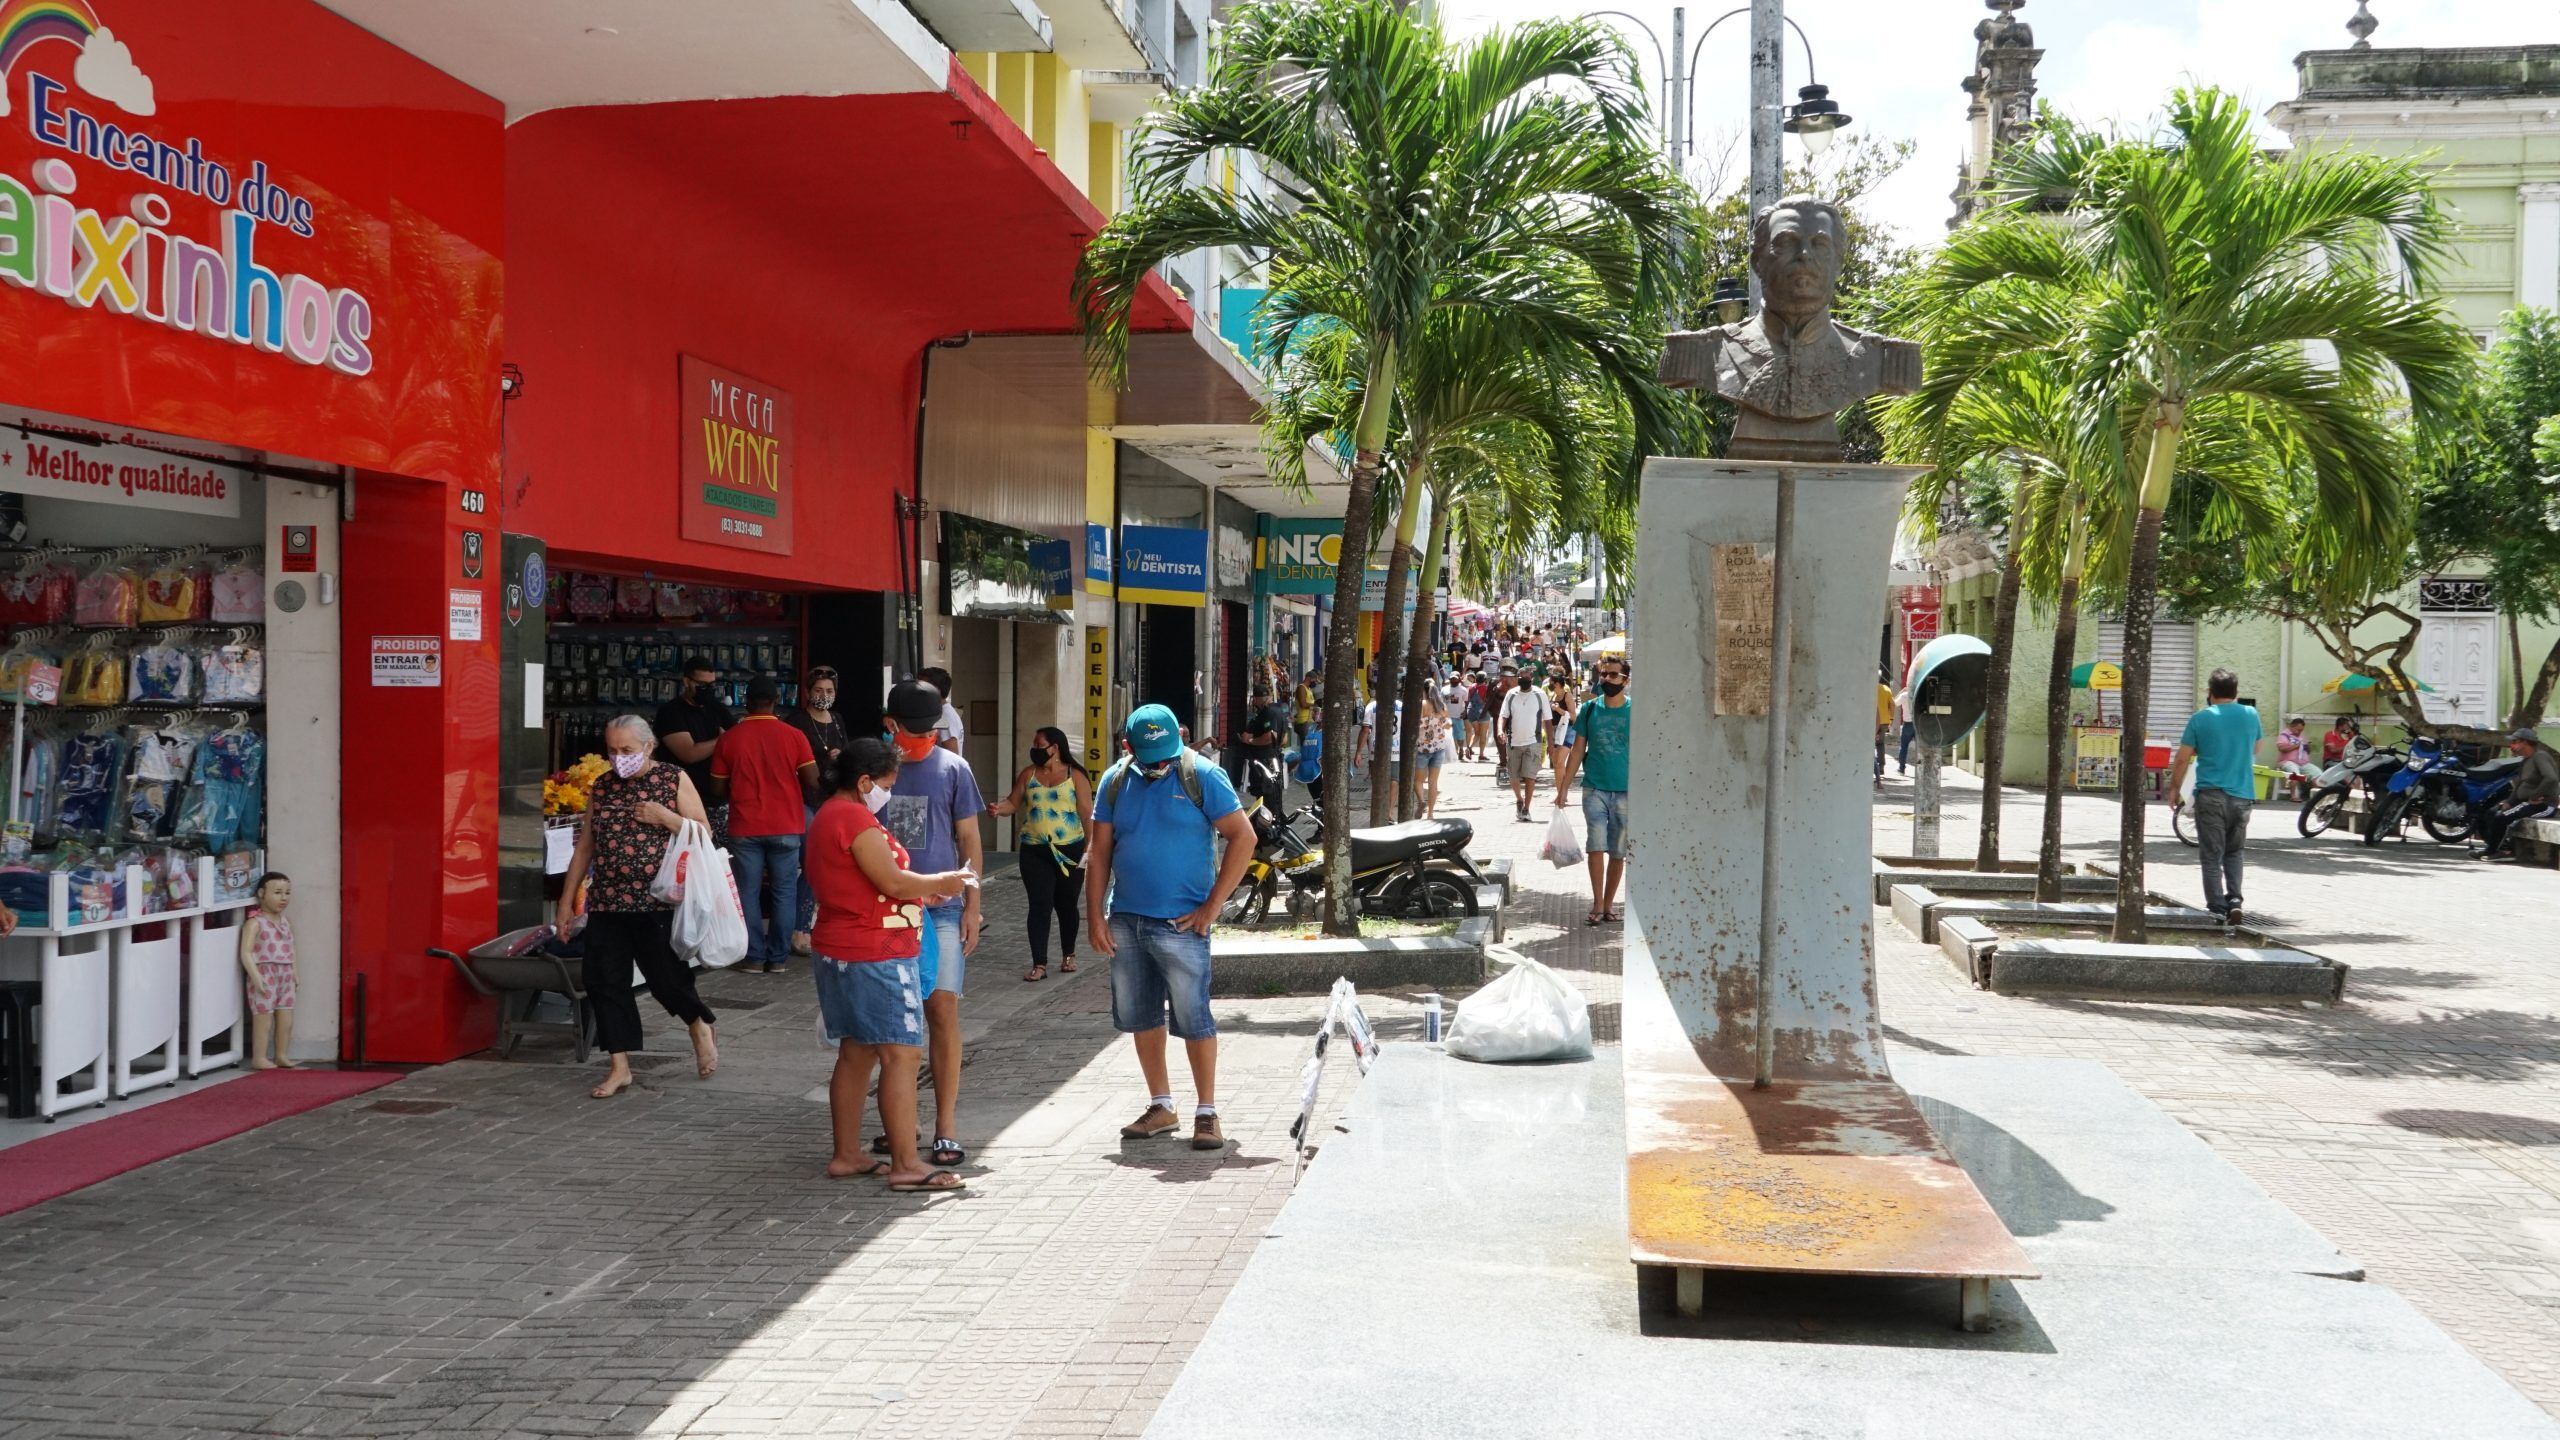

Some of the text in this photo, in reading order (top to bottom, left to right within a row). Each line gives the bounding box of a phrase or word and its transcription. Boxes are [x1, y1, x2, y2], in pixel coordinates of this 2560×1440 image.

[28, 73, 314, 237] Encanto dos
[710, 378, 773, 433] MEGA
[703, 418, 778, 492] WANG
[26, 443, 114, 486] Melhor
[119, 463, 226, 499] qualidade
[461, 490, 484, 513] 460
[721, 517, 733, 535] (83)
[1141, 562, 1202, 576] DENTISTA
[373, 639, 440, 650] PROIBIDO
[374, 655, 419, 664] ENTRAR
[1089, 642, 1103, 800] DENTIST
[1417, 839, 1448, 849] HONDA
